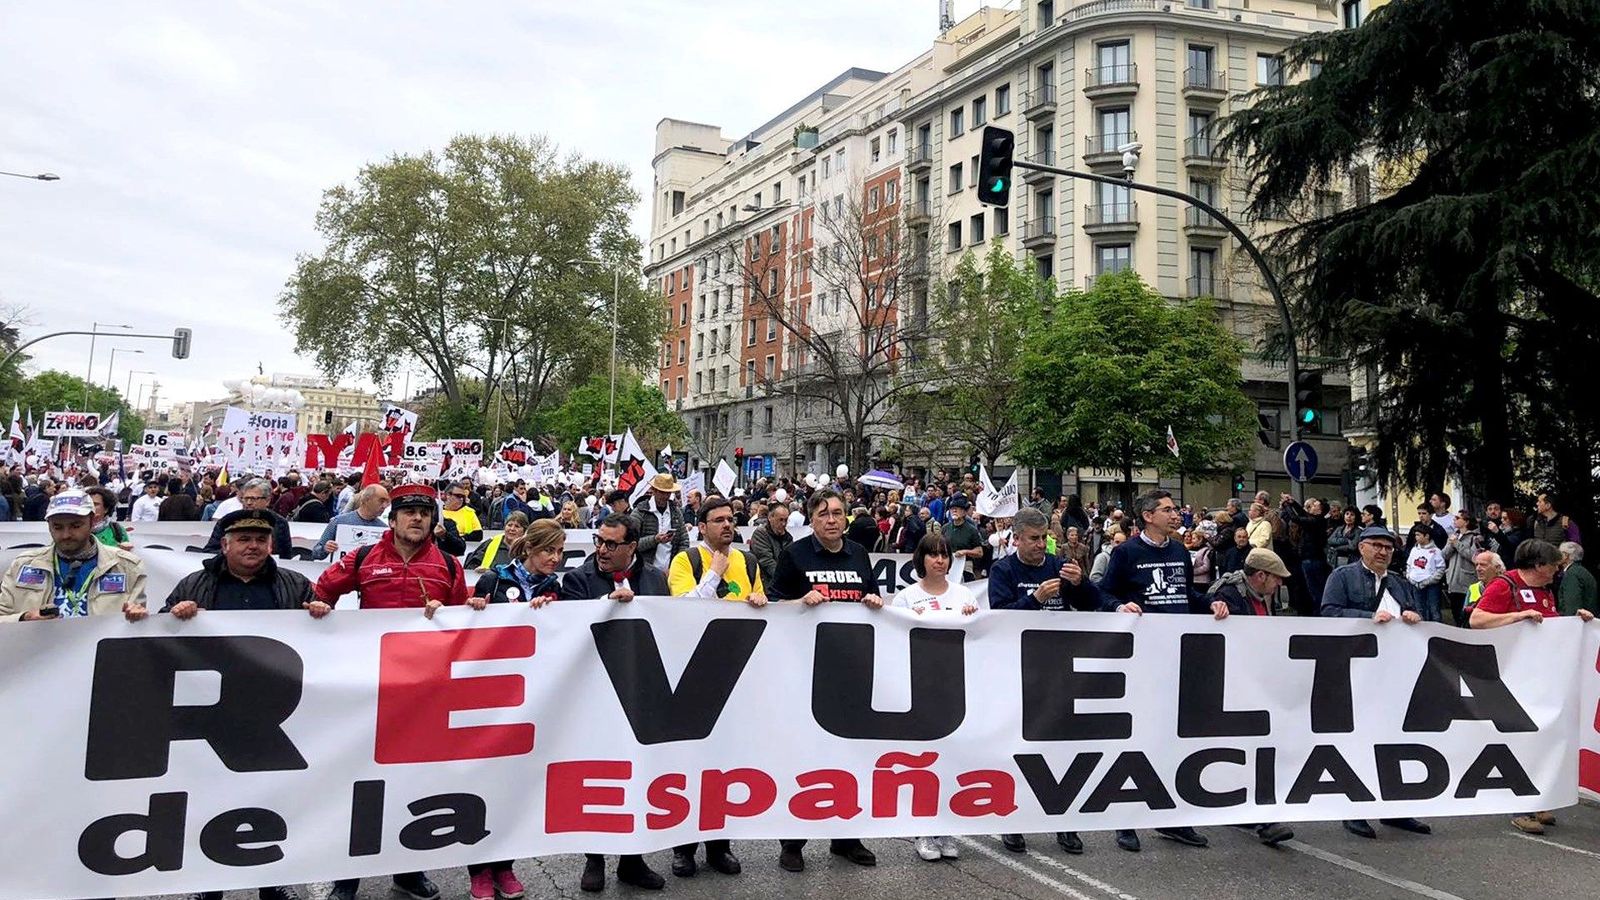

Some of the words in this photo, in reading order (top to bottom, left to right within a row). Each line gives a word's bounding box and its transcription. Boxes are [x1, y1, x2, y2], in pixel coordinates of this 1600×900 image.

[1092, 465, 1144, 478] DIVINS
[805, 570, 863, 584] TERUEL
[84, 618, 1539, 781] REVUELTA
[77, 791, 288, 876] de
[348, 780, 491, 857] la
[544, 751, 1019, 834] España
[1013, 743, 1540, 815] VACIADA
